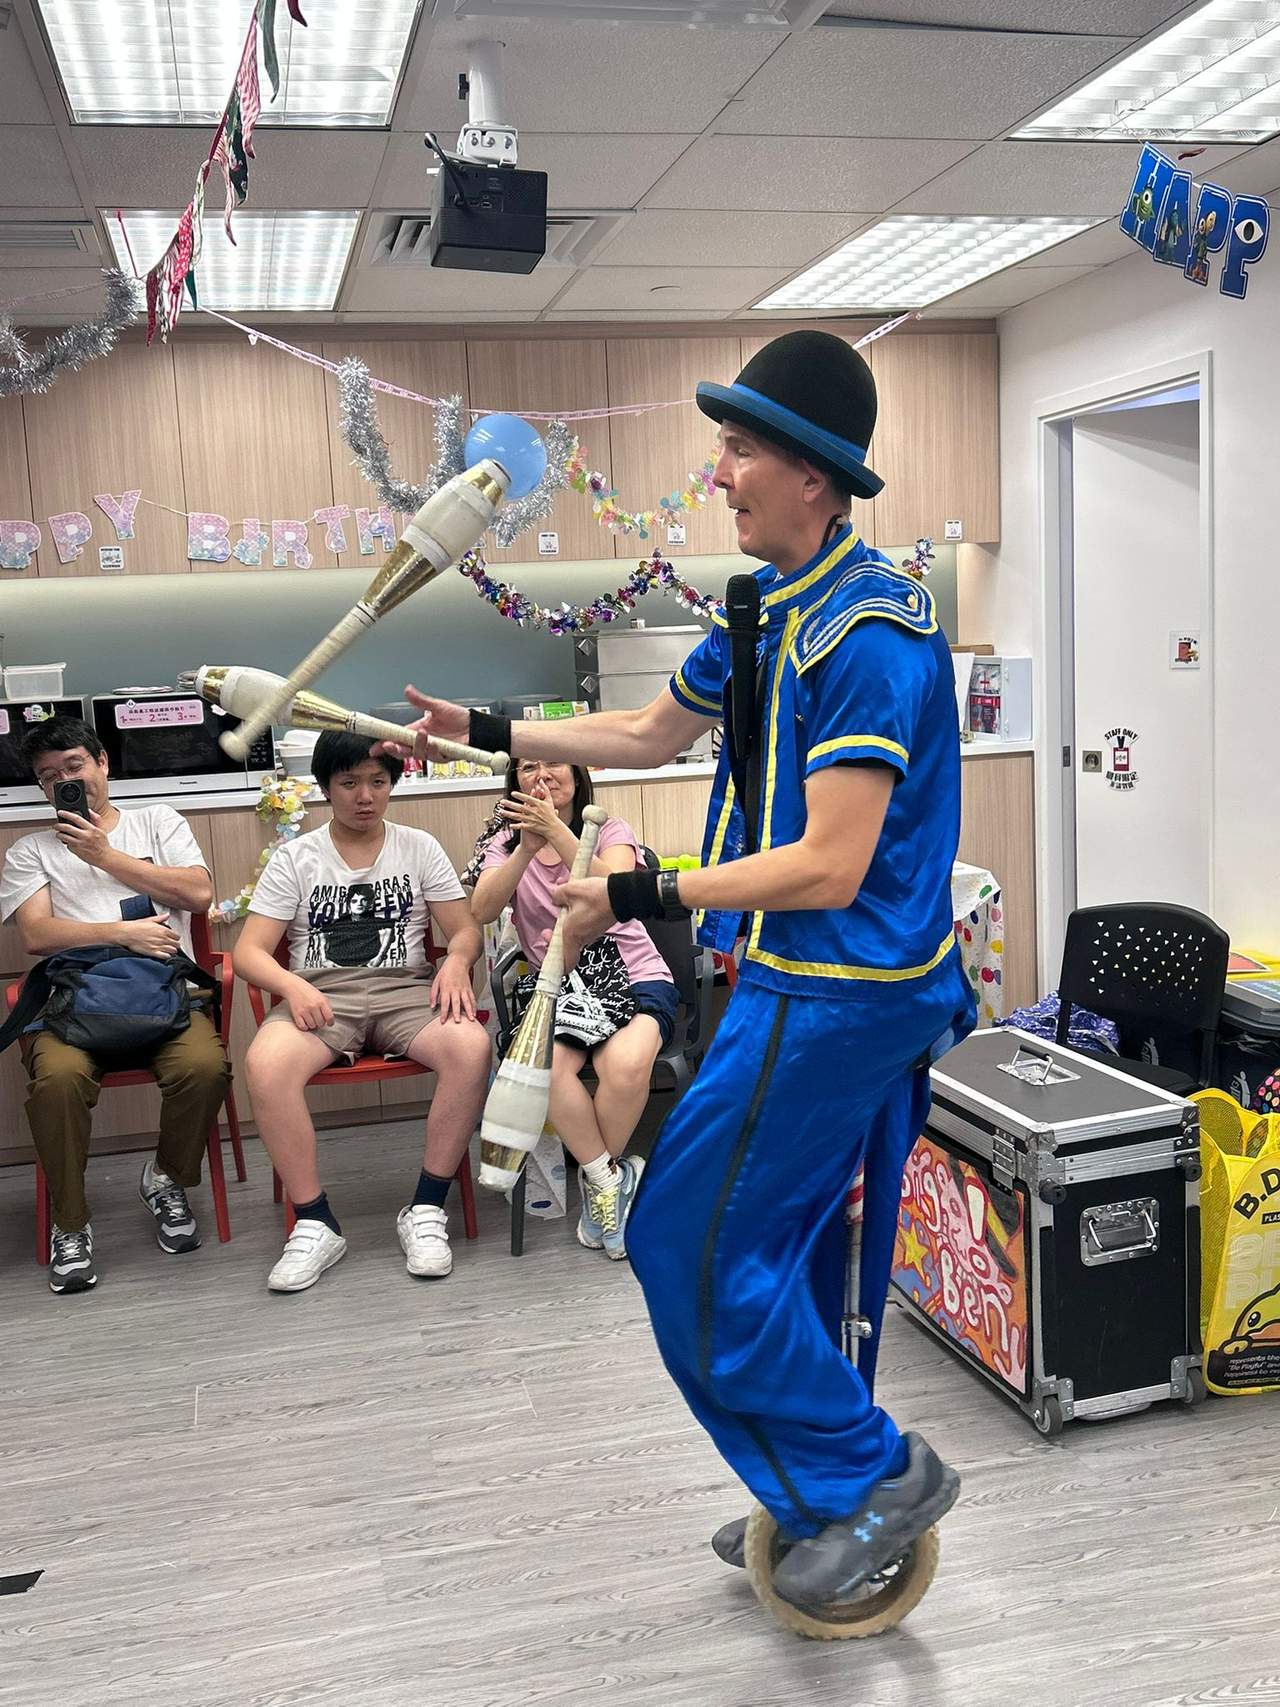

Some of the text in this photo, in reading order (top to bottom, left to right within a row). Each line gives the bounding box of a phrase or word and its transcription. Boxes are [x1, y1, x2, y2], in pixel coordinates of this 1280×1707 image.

[187, 503, 514, 570] BIRTH
[1104, 728, 1138, 741] STAFF ONLY
